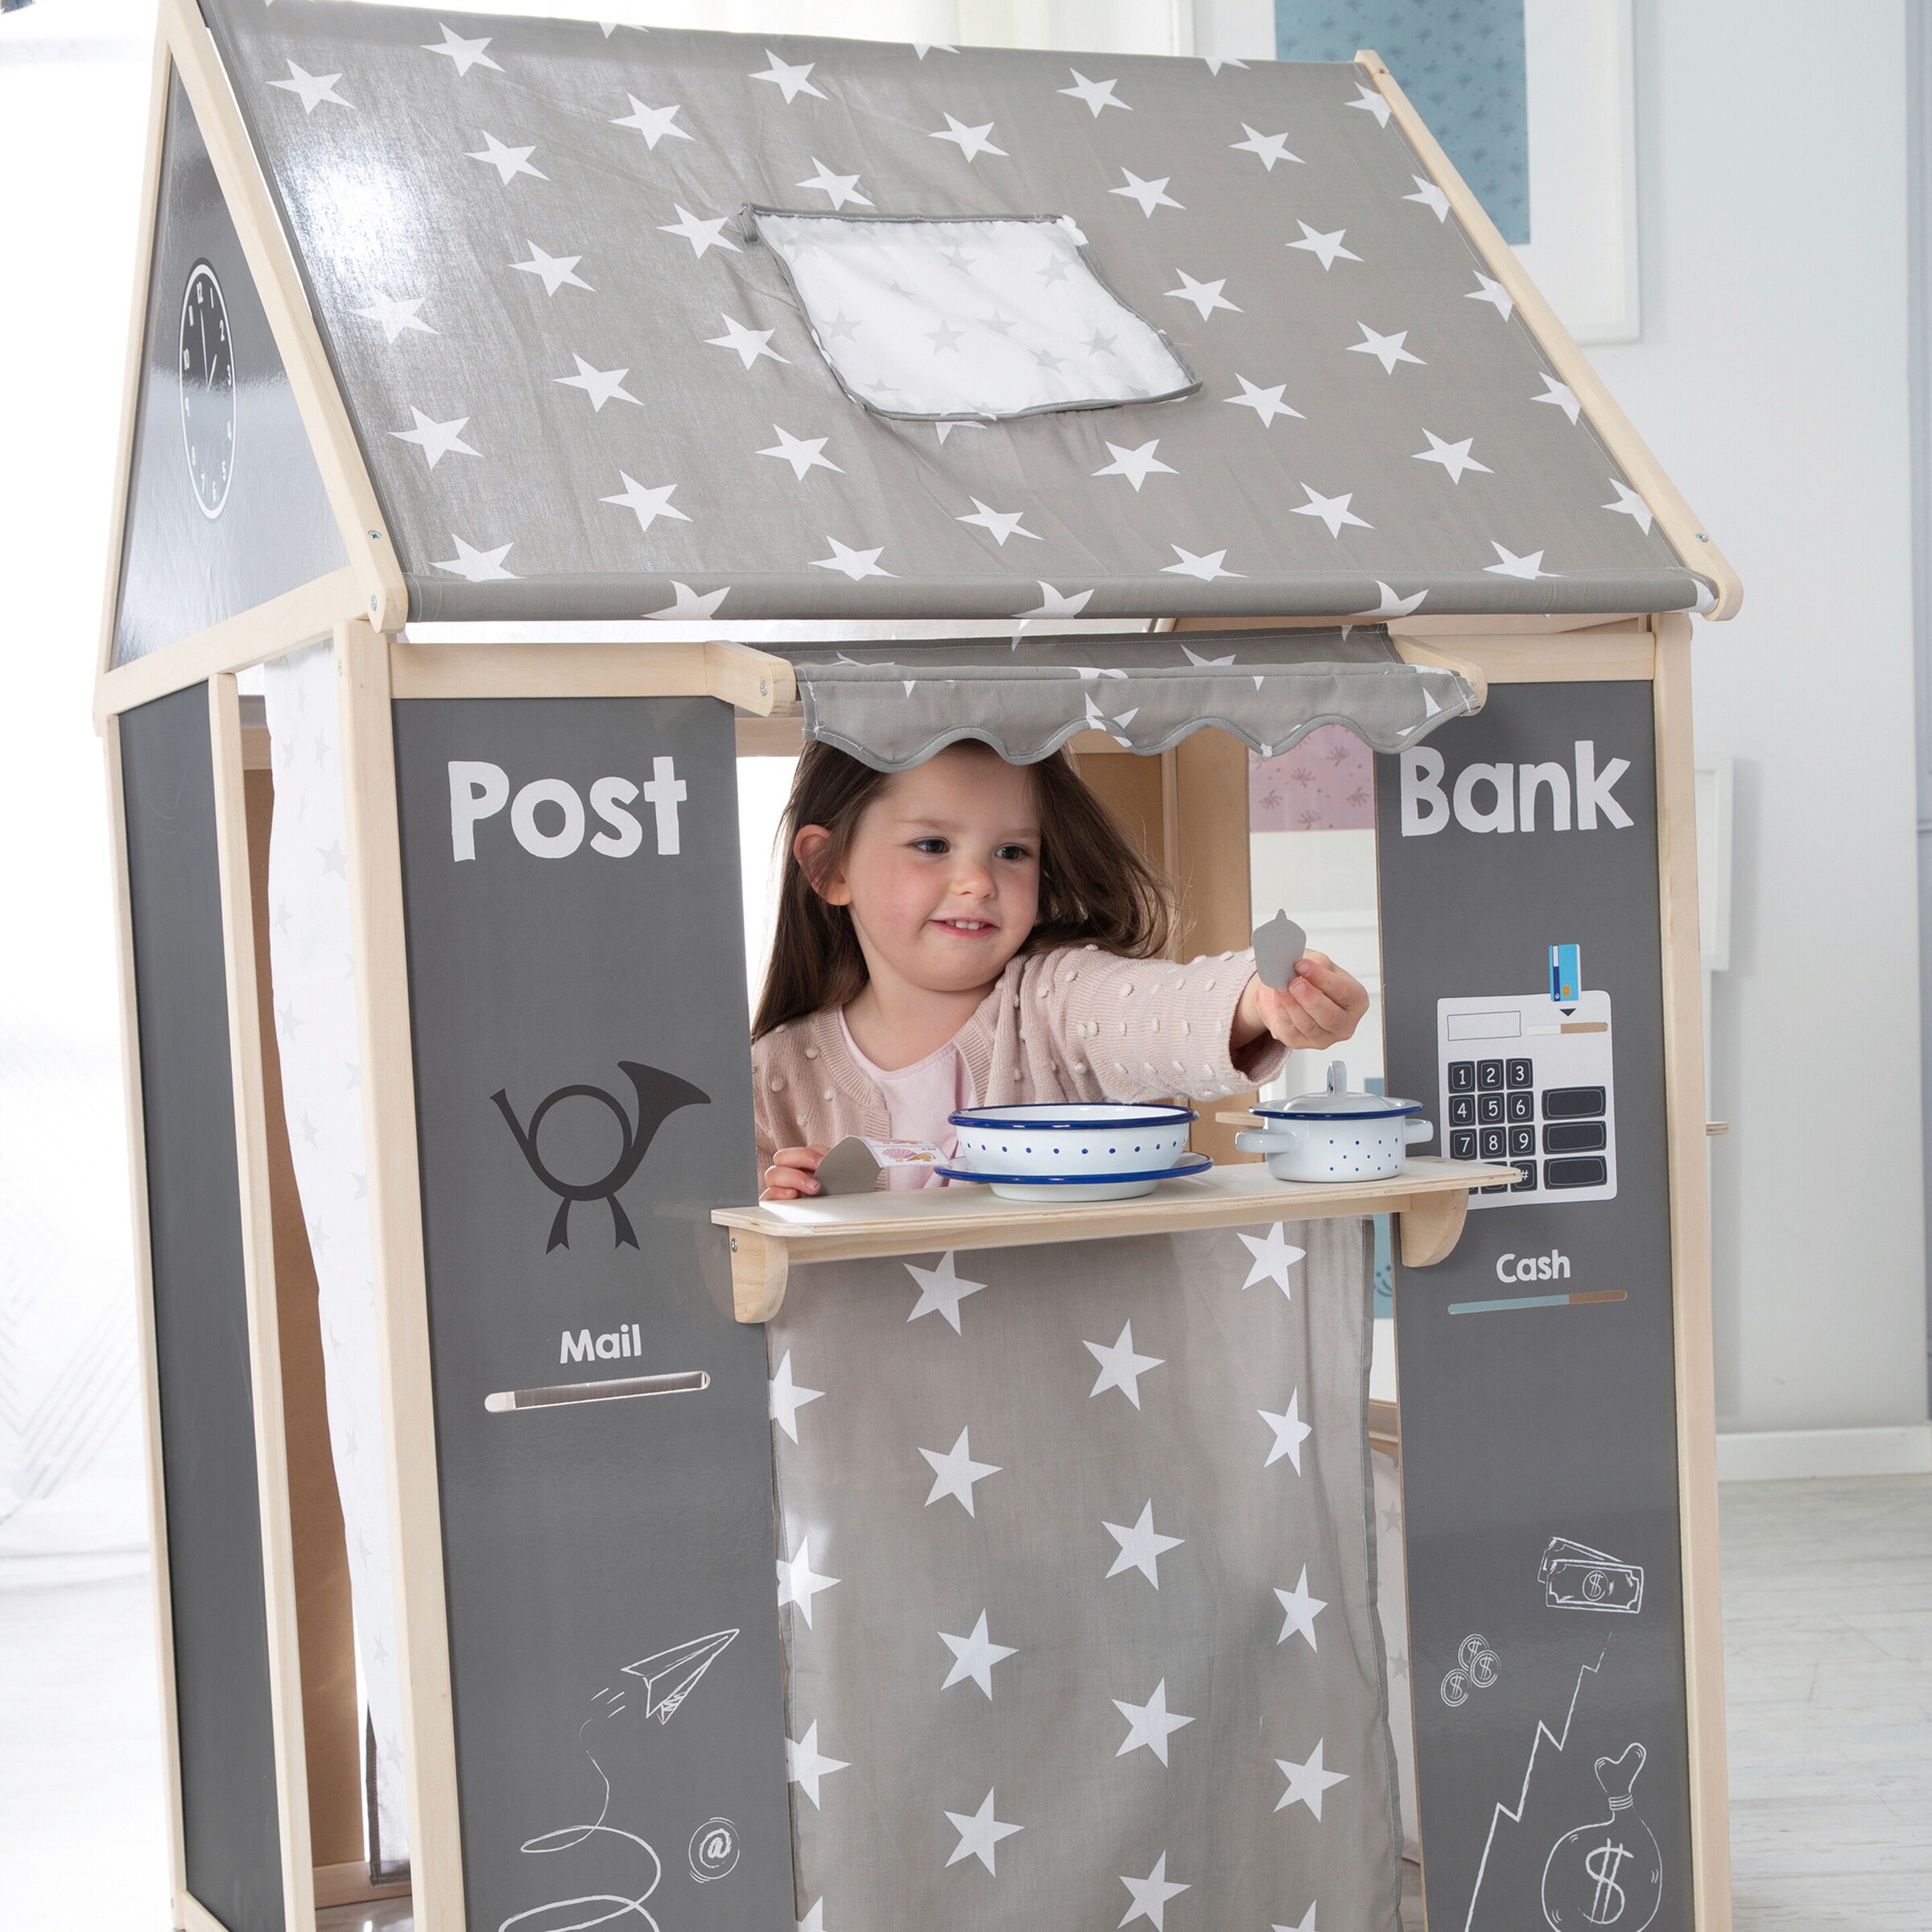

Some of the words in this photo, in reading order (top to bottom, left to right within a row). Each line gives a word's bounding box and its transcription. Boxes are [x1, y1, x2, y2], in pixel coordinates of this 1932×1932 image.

[196, 281, 204, 304] 12
[219, 319, 225, 342] 2
[226, 364, 233, 386] 3
[1400, 740, 1634, 837] Bank
[448, 756, 687, 862] Post
[1459, 1068, 1466, 1085] 1
[1486, 1067, 1496, 1084] 2
[1515, 1065, 1525, 1081] 3
[1457, 1102, 1468, 1118] 4
[1488, 1100, 1498, 1117] 5
[1516, 1099, 1525, 1116] 6
[1460, 1137, 1471, 1154] 7
[1488, 1134, 1498, 1151] 8
[1519, 1133, 1529, 1150] 9
[1496, 1249, 1571, 1284] Cash
[559, 1323, 642, 1364] Mail
[699, 1827, 733, 1869] @
[1577, 1838, 1634, 1926] $
